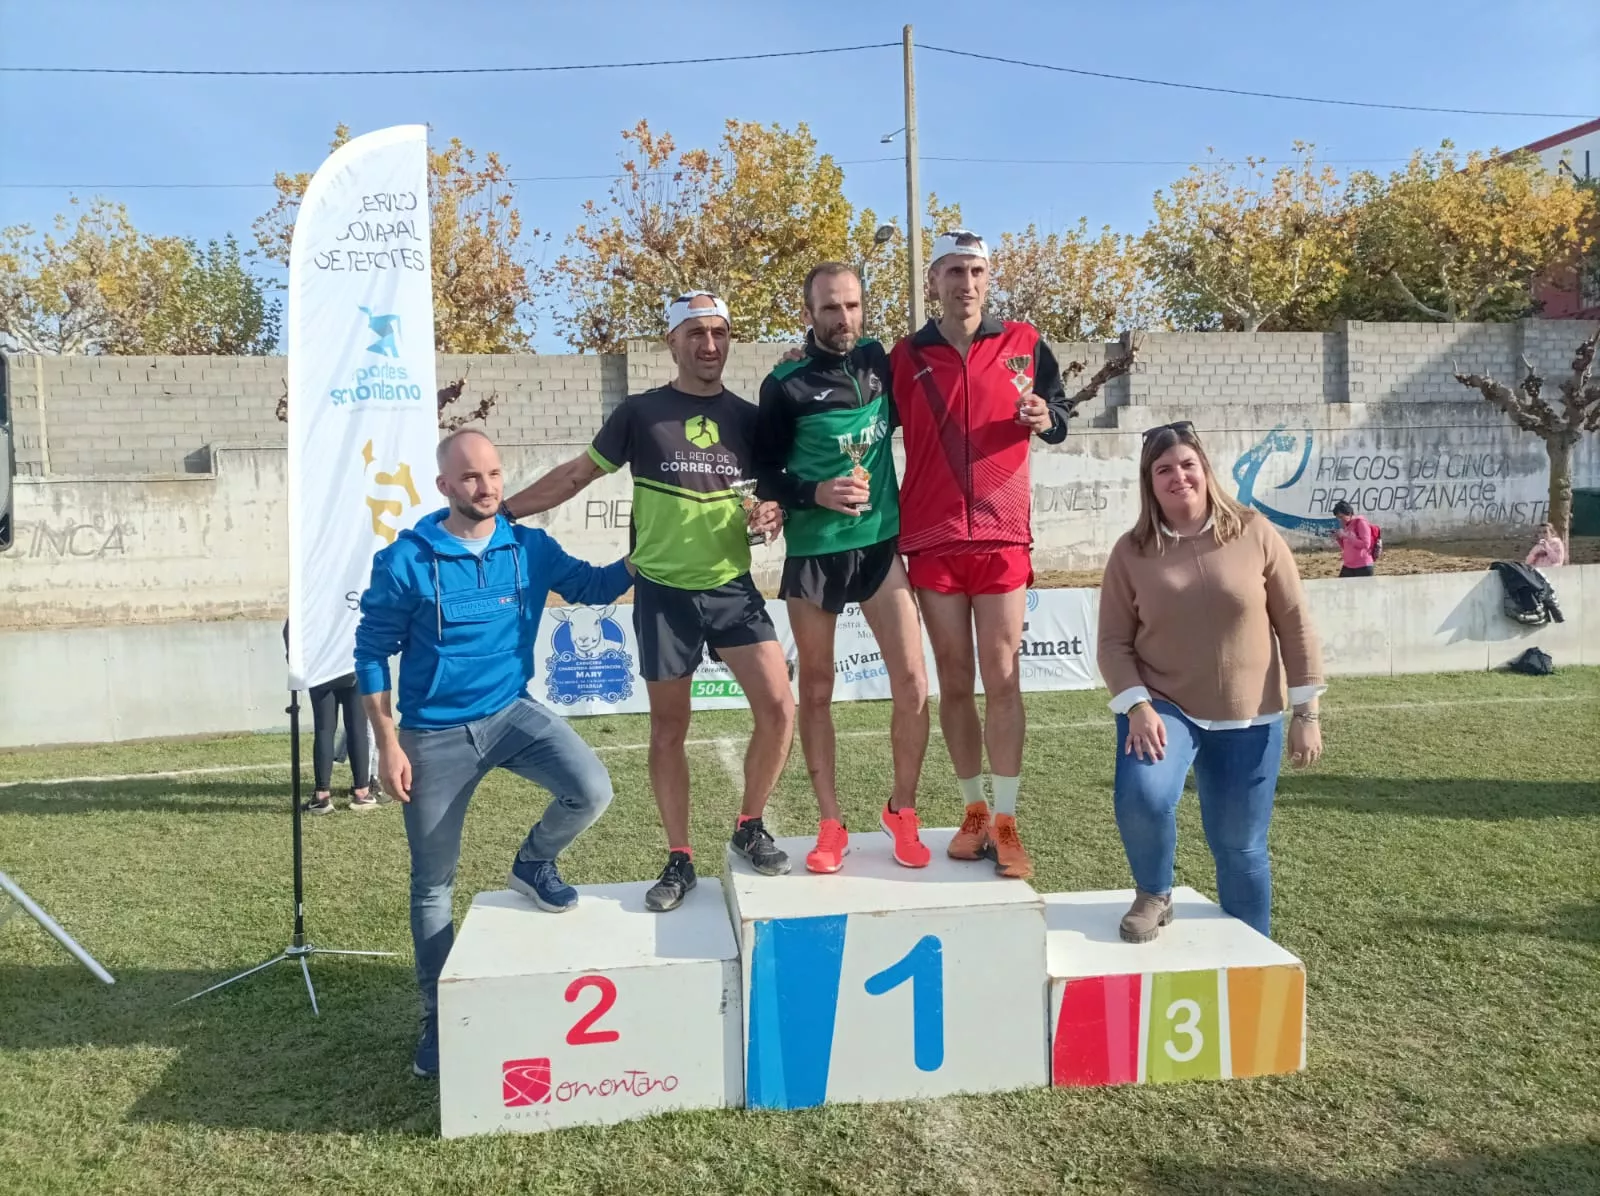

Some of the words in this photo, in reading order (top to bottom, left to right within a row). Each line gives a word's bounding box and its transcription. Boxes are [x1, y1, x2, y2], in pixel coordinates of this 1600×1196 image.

[675, 451, 687, 460] EL
[689, 452, 715, 462] RETO
[716, 454, 730, 464] DE
[660, 461, 742, 477] CORRER.COM
[1316, 456, 1402, 481] RIEGOS
[1469, 480, 1497, 501] de
[1018, 636, 1083, 657] amat
[844, 663, 888, 684] Estad
[696, 682, 725, 695] 504
[564, 975, 620, 1046] 2
[864, 934, 944, 1072] 1
[1164, 998, 1204, 1062] 3
